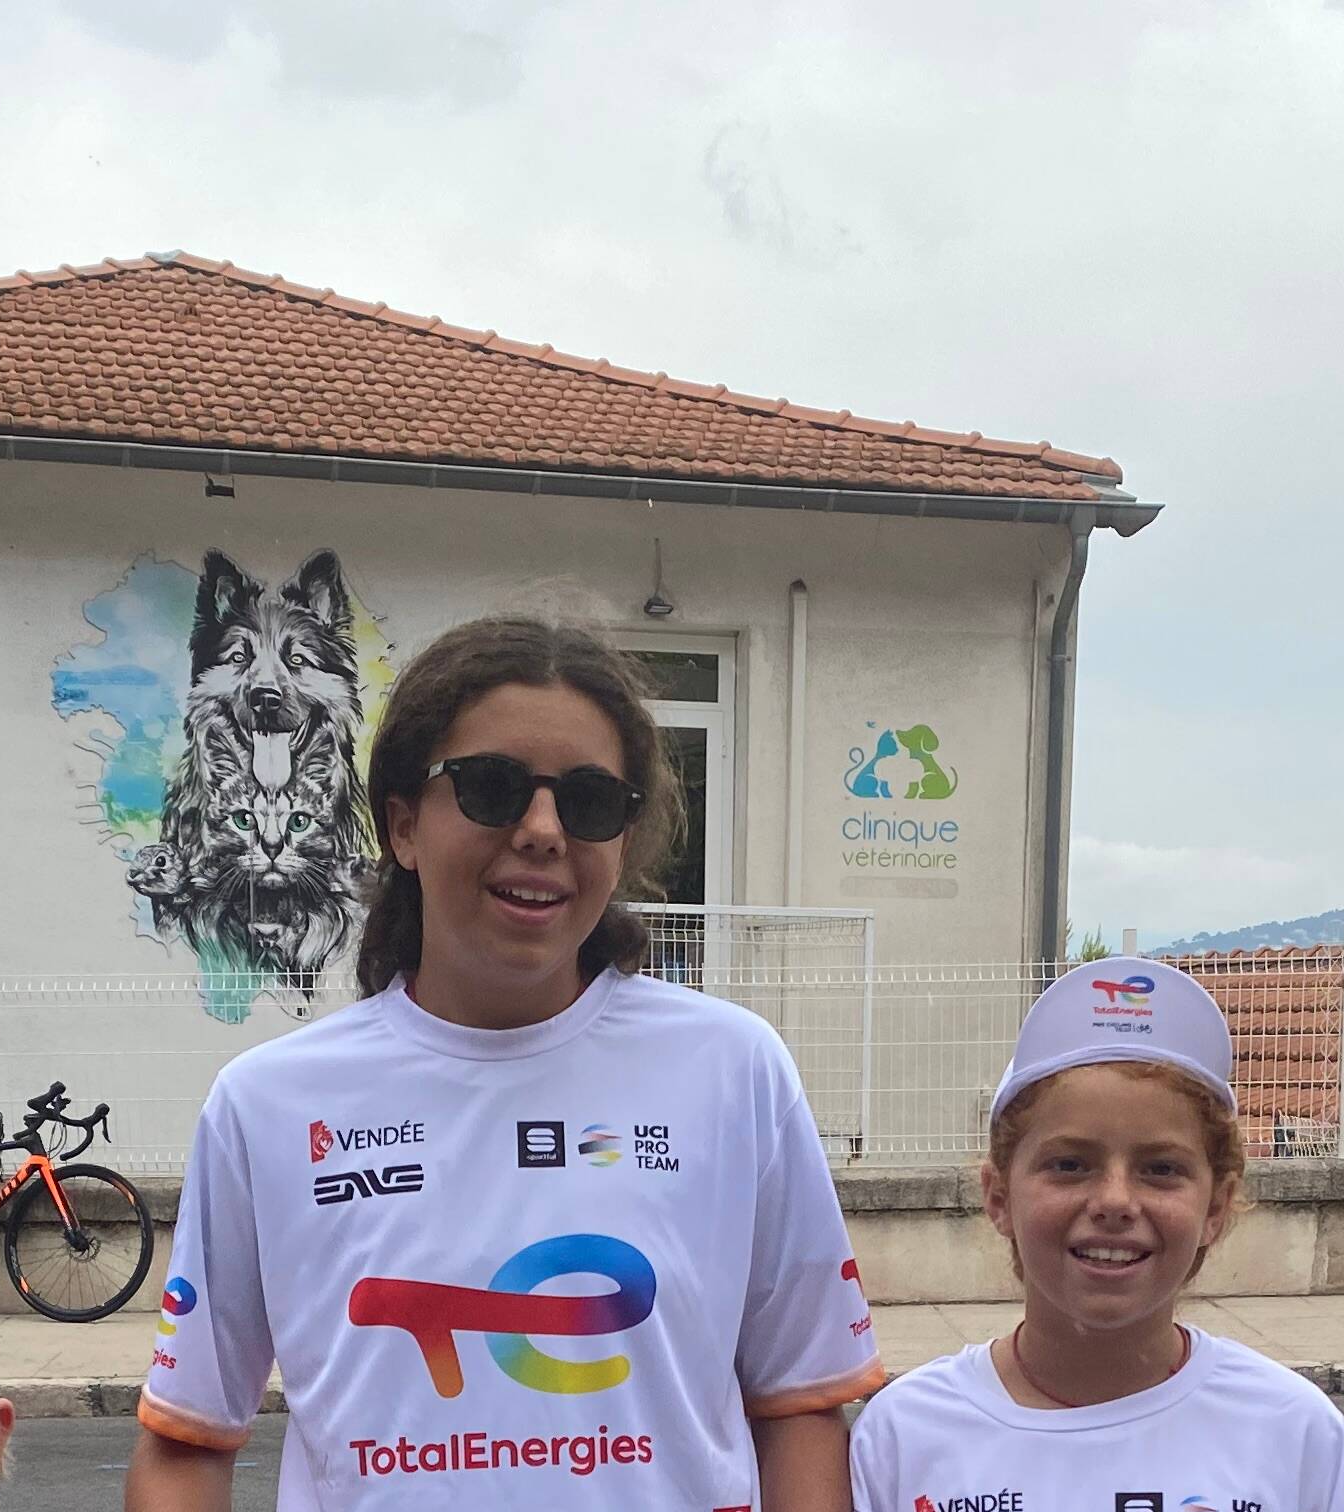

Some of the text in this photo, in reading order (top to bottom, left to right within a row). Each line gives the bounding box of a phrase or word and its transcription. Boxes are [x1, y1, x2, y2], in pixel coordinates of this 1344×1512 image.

[842, 811, 959, 849] clinique
[842, 847, 958, 869] vétérinaire
[336, 1120, 425, 1151] VENDÉE
[634, 1125, 669, 1139] UCI
[634, 1140, 669, 1155] PRO
[635, 1155, 679, 1172] TEAM
[349, 1425, 654, 1477] TotalEnergies
